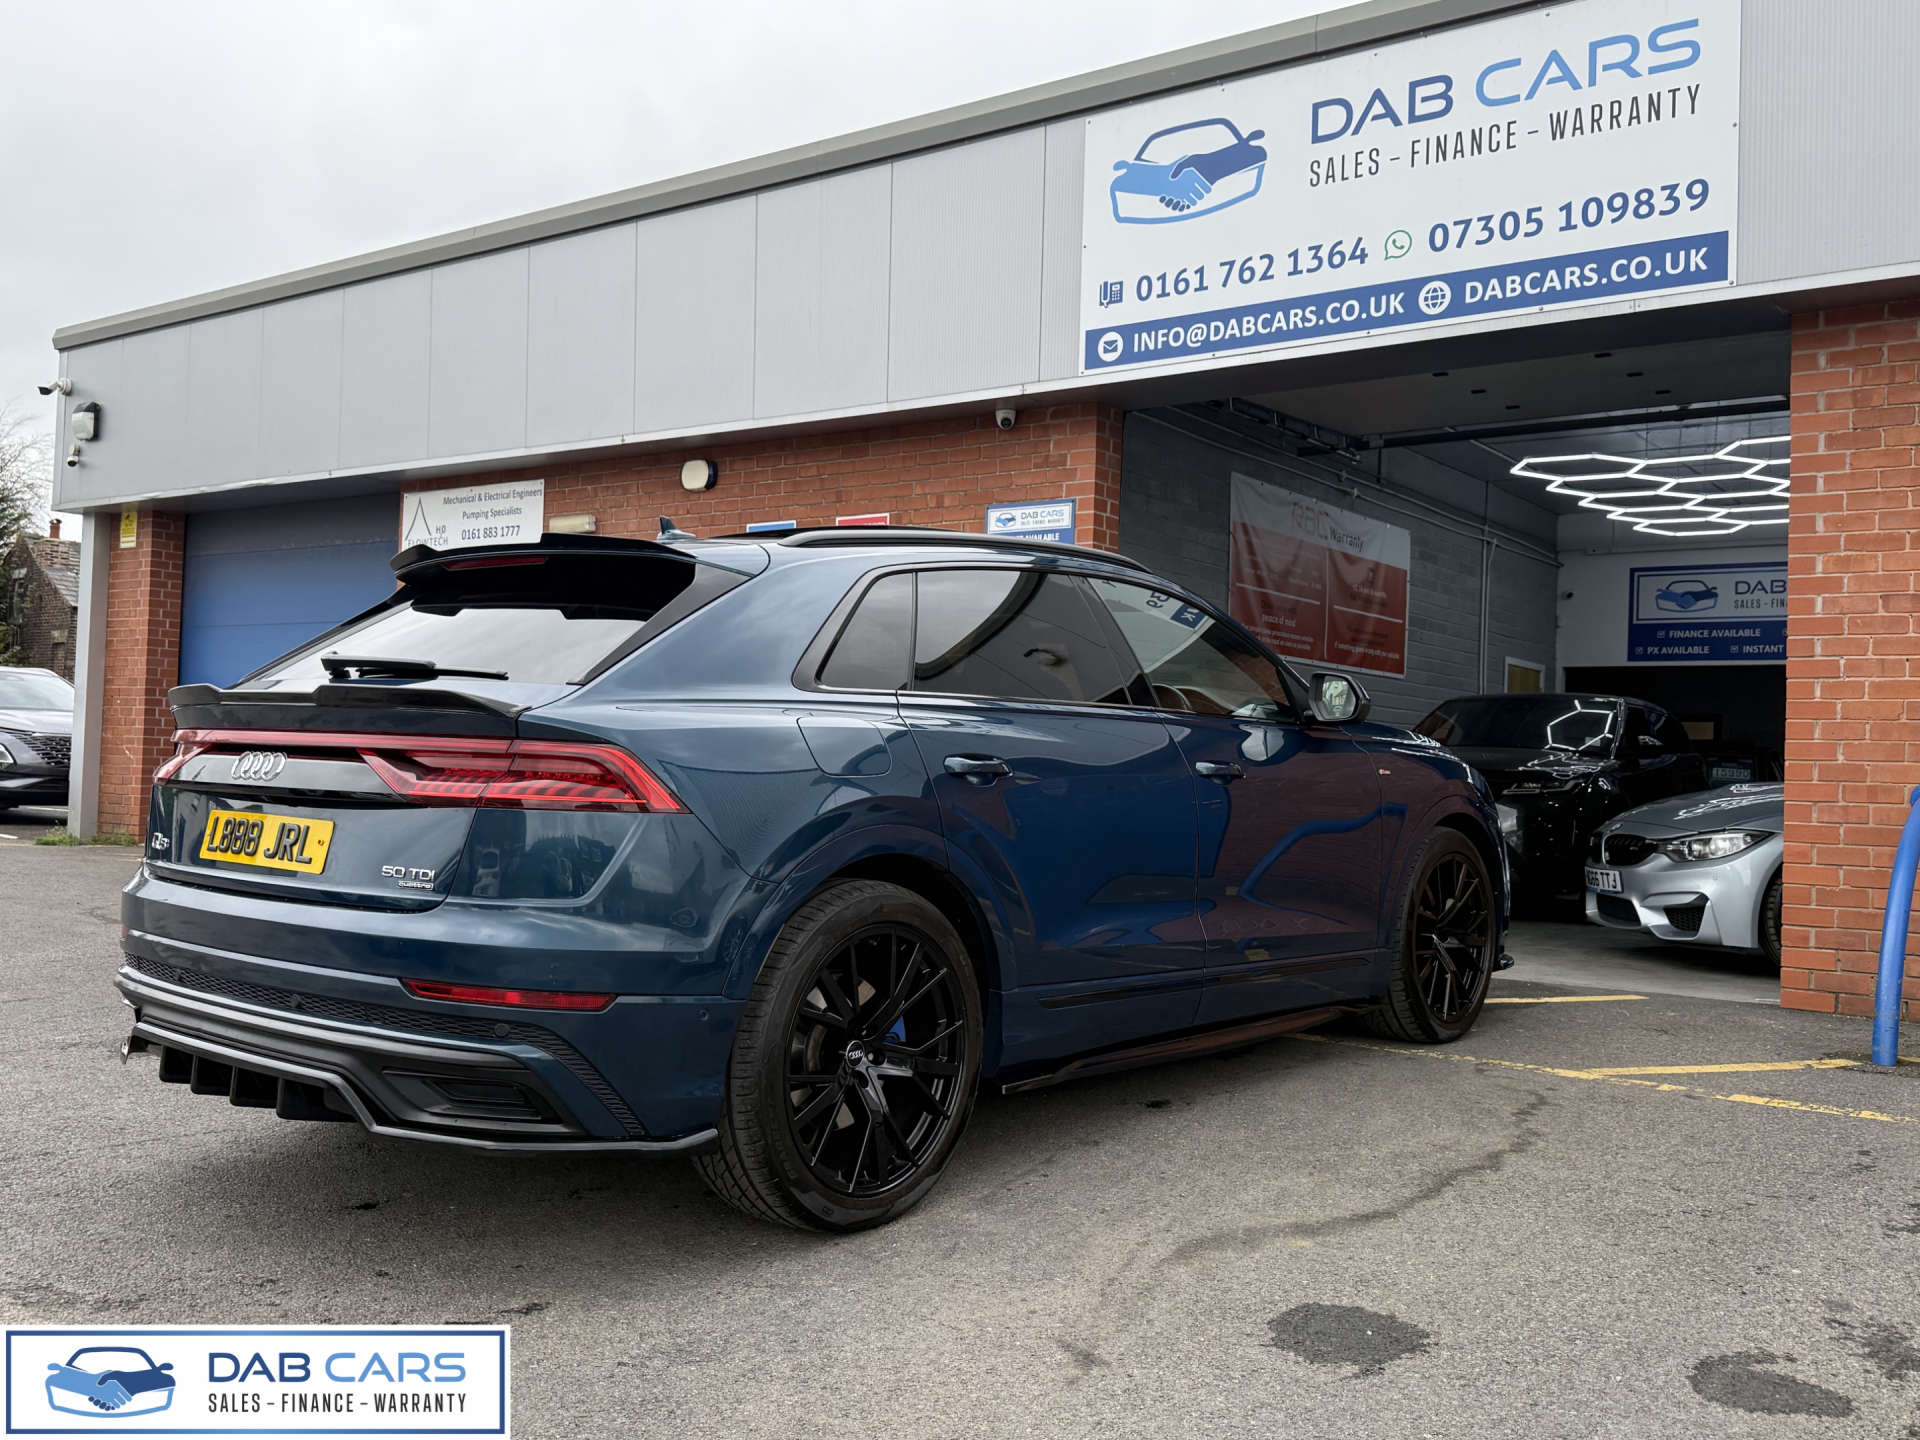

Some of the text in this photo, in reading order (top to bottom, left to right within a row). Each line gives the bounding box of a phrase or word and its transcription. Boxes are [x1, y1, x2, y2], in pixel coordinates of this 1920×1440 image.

[1311, 18, 1701, 145] DAB CARS
[1309, 147, 1380, 188] SALES
[1410, 120, 1517, 168] FINANCE
[1549, 83, 1700, 142] WARRANTY
[1428, 178, 1710, 252] 07305 109839
[1136, 236, 1369, 302] 0161 762 1364
[1464, 247, 1709, 304] DABCARS.CO.UK
[1133, 291, 1405, 353] INFO@DABCARS.CO.UK
[443, 488, 542, 505] Mechanical & Electrical Engineers
[462, 507, 522, 521] Pumping Specialists
[1021, 511, 1038, 520] DAB
[461, 525, 520, 541] 0161 883 1777
[1735, 579, 1787, 595] DAB
[1734, 598, 1761, 609] SALES
[1669, 628, 1761, 639] FINANCE AVAILABLE
[1647, 644, 1784, 655] PX AVAILABLE INSTANT
[207, 816, 313, 865] L888 JRL
[381, 865, 435, 881] 50 TDI
